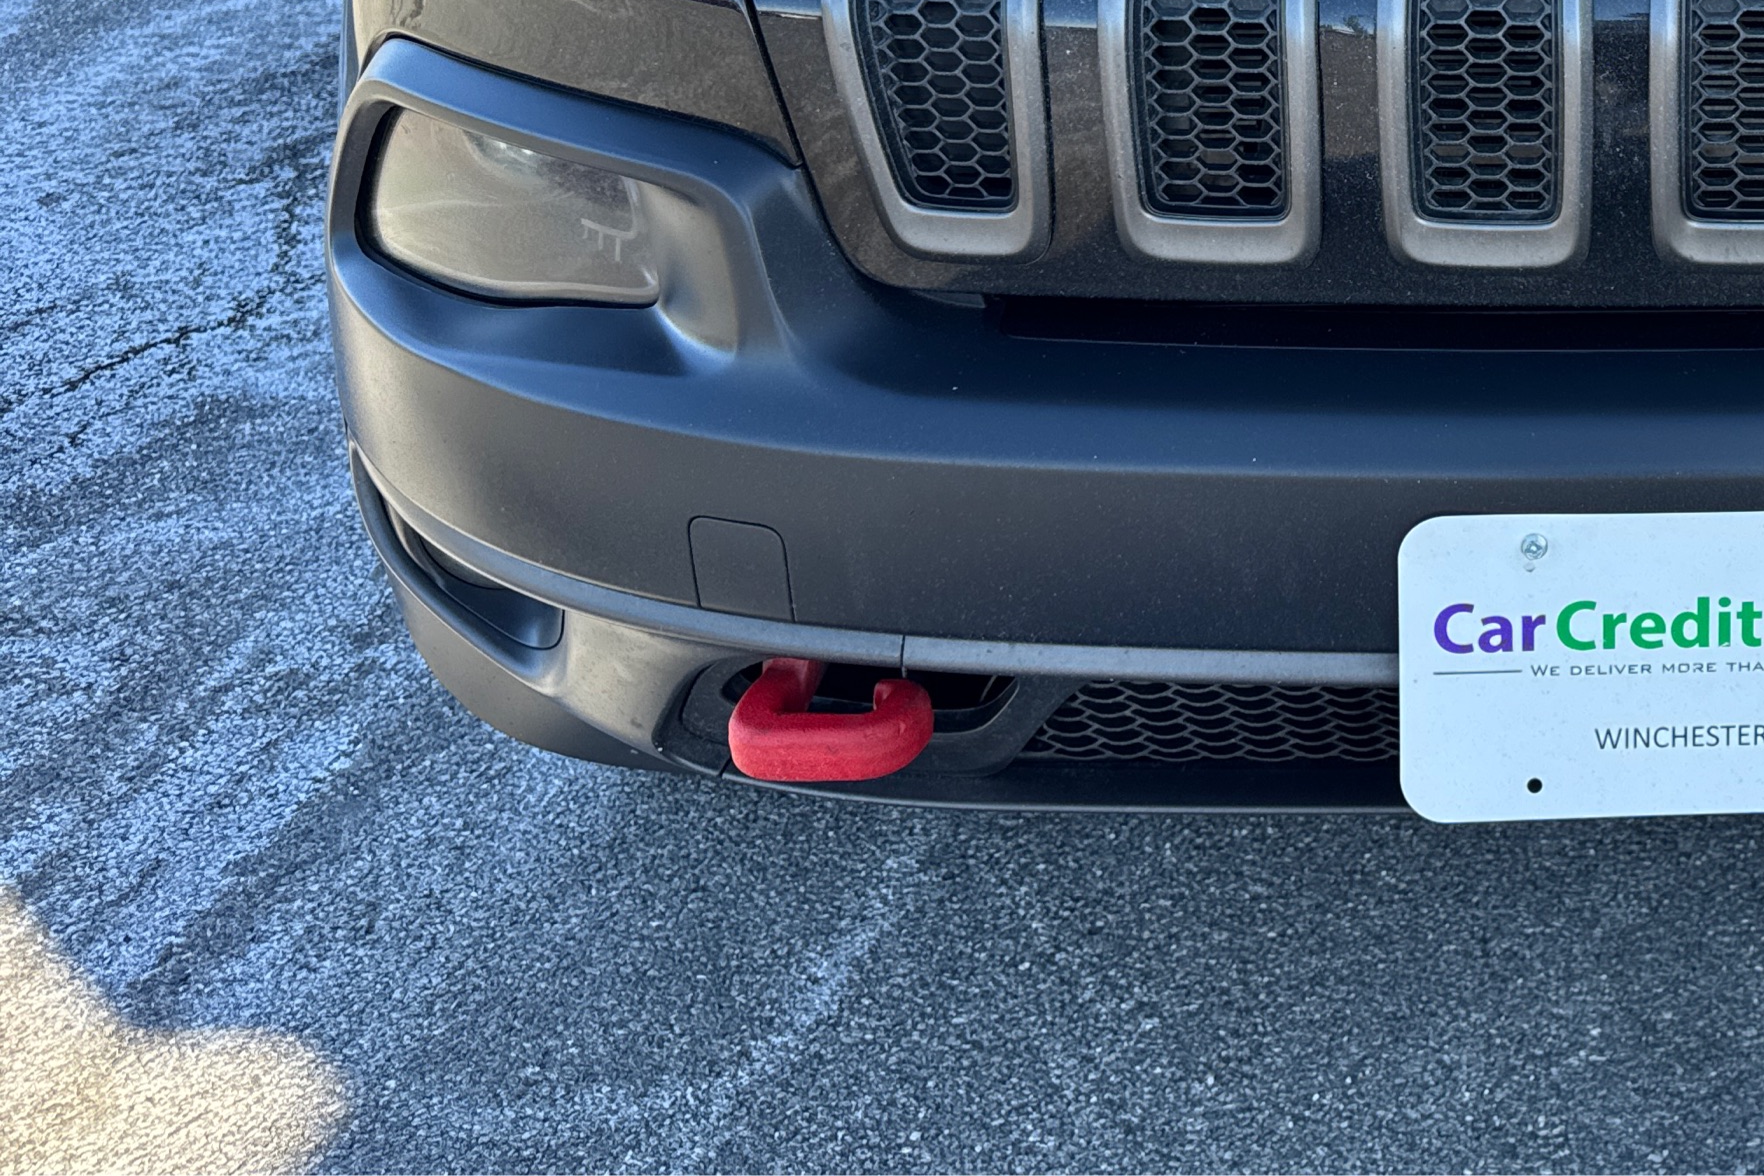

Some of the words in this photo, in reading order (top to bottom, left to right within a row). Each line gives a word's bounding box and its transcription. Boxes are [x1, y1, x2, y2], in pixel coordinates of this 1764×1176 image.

[1433, 603, 1547, 654] Car
[1556, 596, 1763, 651] Credit
[1530, 664, 1561, 677] WE
[1570, 663, 1653, 676] DELIVER
[1661, 662, 1718, 674] MORE
